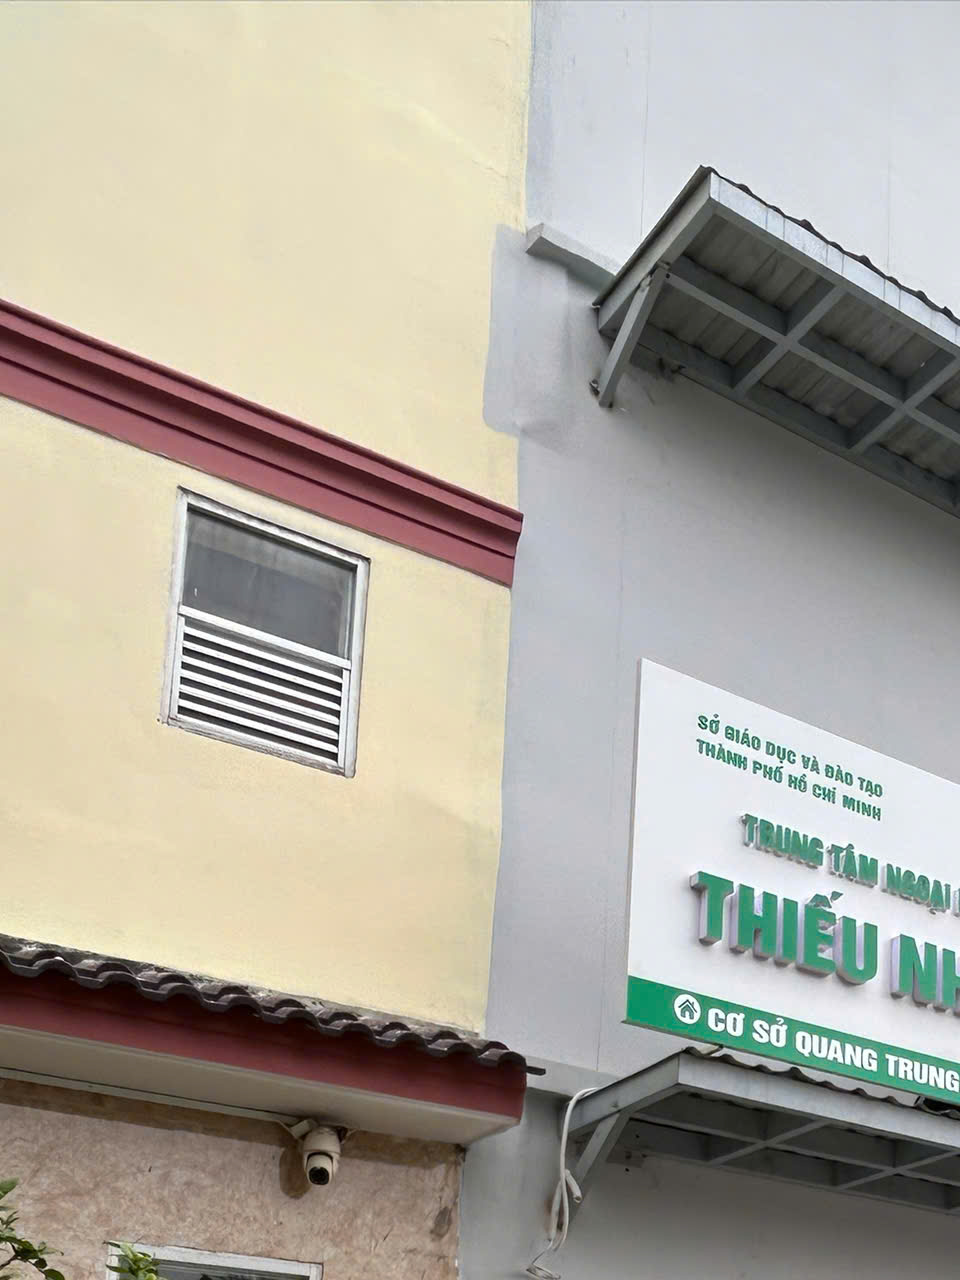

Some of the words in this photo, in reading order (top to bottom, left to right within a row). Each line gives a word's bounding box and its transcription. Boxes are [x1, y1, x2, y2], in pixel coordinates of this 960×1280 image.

[696, 738, 747, 771] THÀNH
[752, 760, 784, 784] PHỐ
[788, 773, 807, 793] HỒ
[812, 783, 837, 804] CHÍ
[842, 794, 881, 821] MINH
[697, 713, 721, 735] SỞ
[724, 728, 761, 751] GIÁO
[765, 741, 797, 764] DỤC
[801, 754, 820, 775] VÀ
[824, 764, 853, 787] ĐÀO
[857, 775, 883, 798] TẠO
[740, 813, 824, 869] TRUNG
[827, 843, 878, 888] TÂM
[881, 863, 952, 915] NGOẠI
[690, 870, 879, 985] THIẾU
[707, 1008, 745, 1037] CƠ
[752, 1017, 788, 1048] SỞ
[795, 1030, 878, 1072] QUANG
